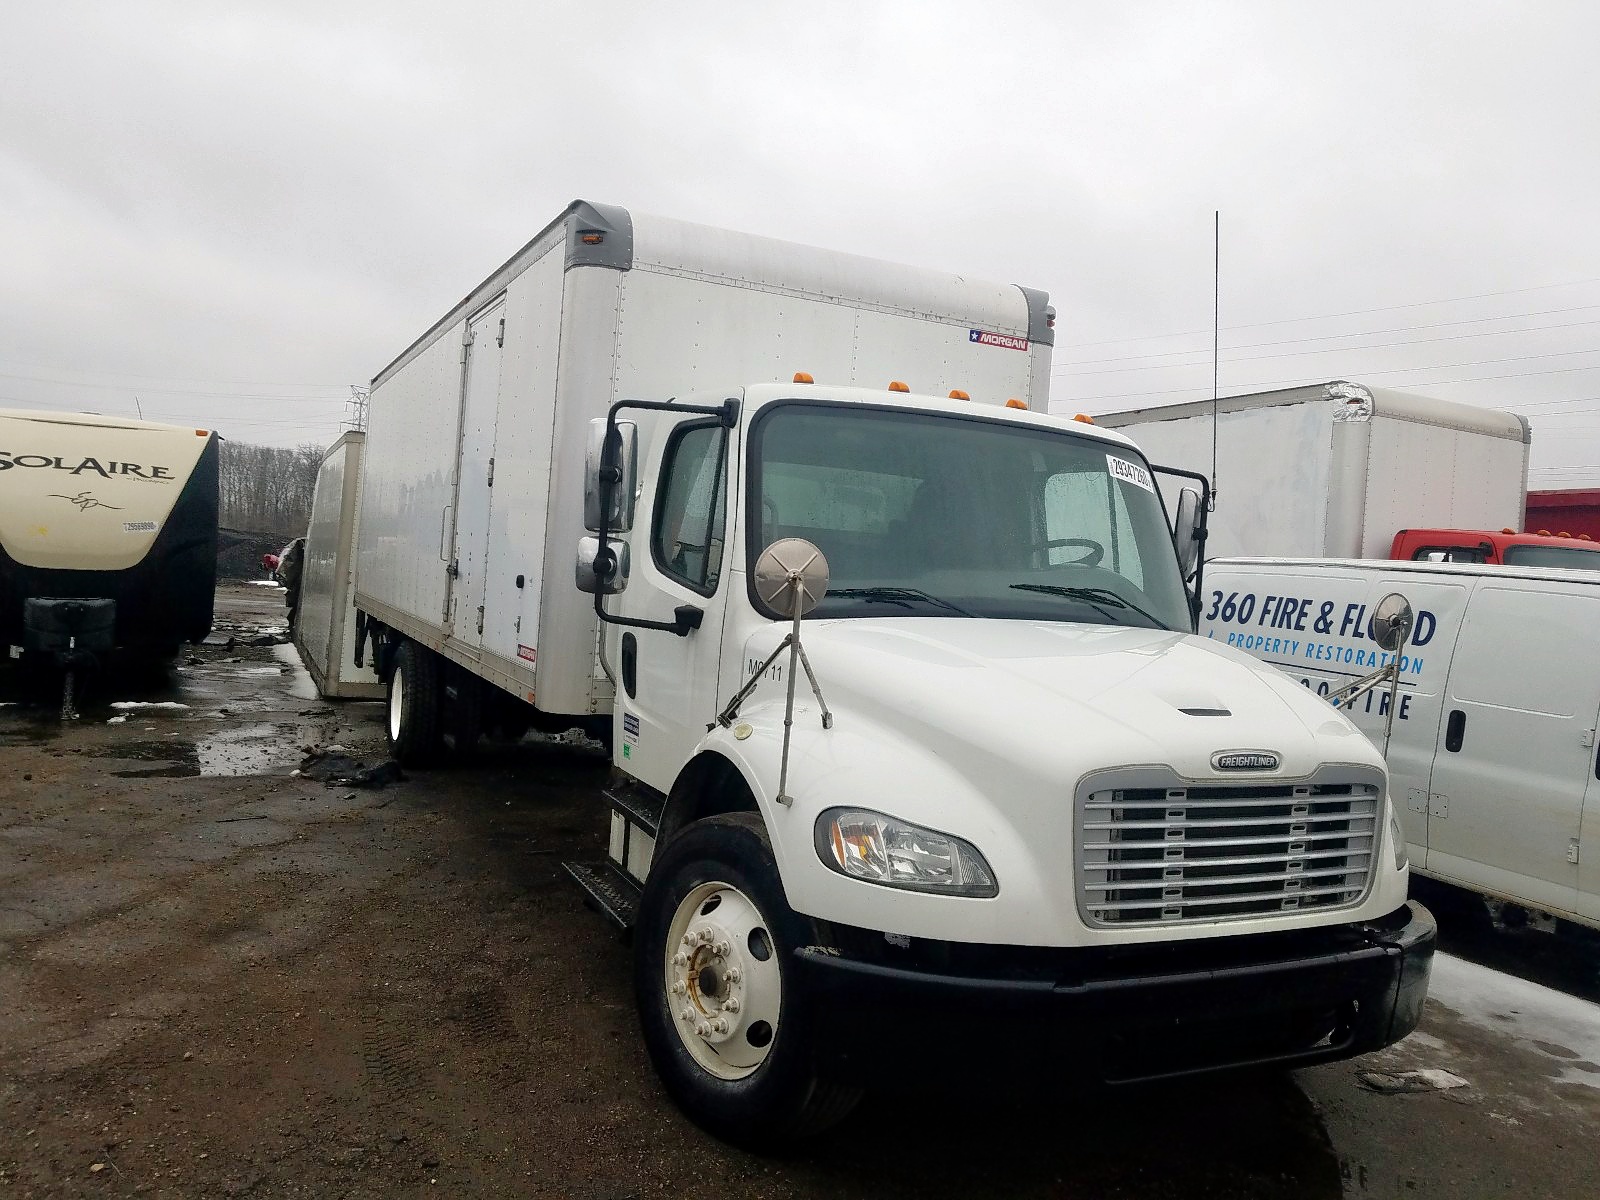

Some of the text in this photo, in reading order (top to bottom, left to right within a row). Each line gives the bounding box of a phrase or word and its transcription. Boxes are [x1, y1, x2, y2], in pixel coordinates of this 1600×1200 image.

[980, 333, 1026, 349] MORGAN
[1206, 590, 1437, 646] 360 FIRE & FLD
[1228, 632, 1300, 656] PROPERTY
[1346, 685, 1412, 721] FIRE
[1220, 756, 1275, 767] FREIGHTLINER
